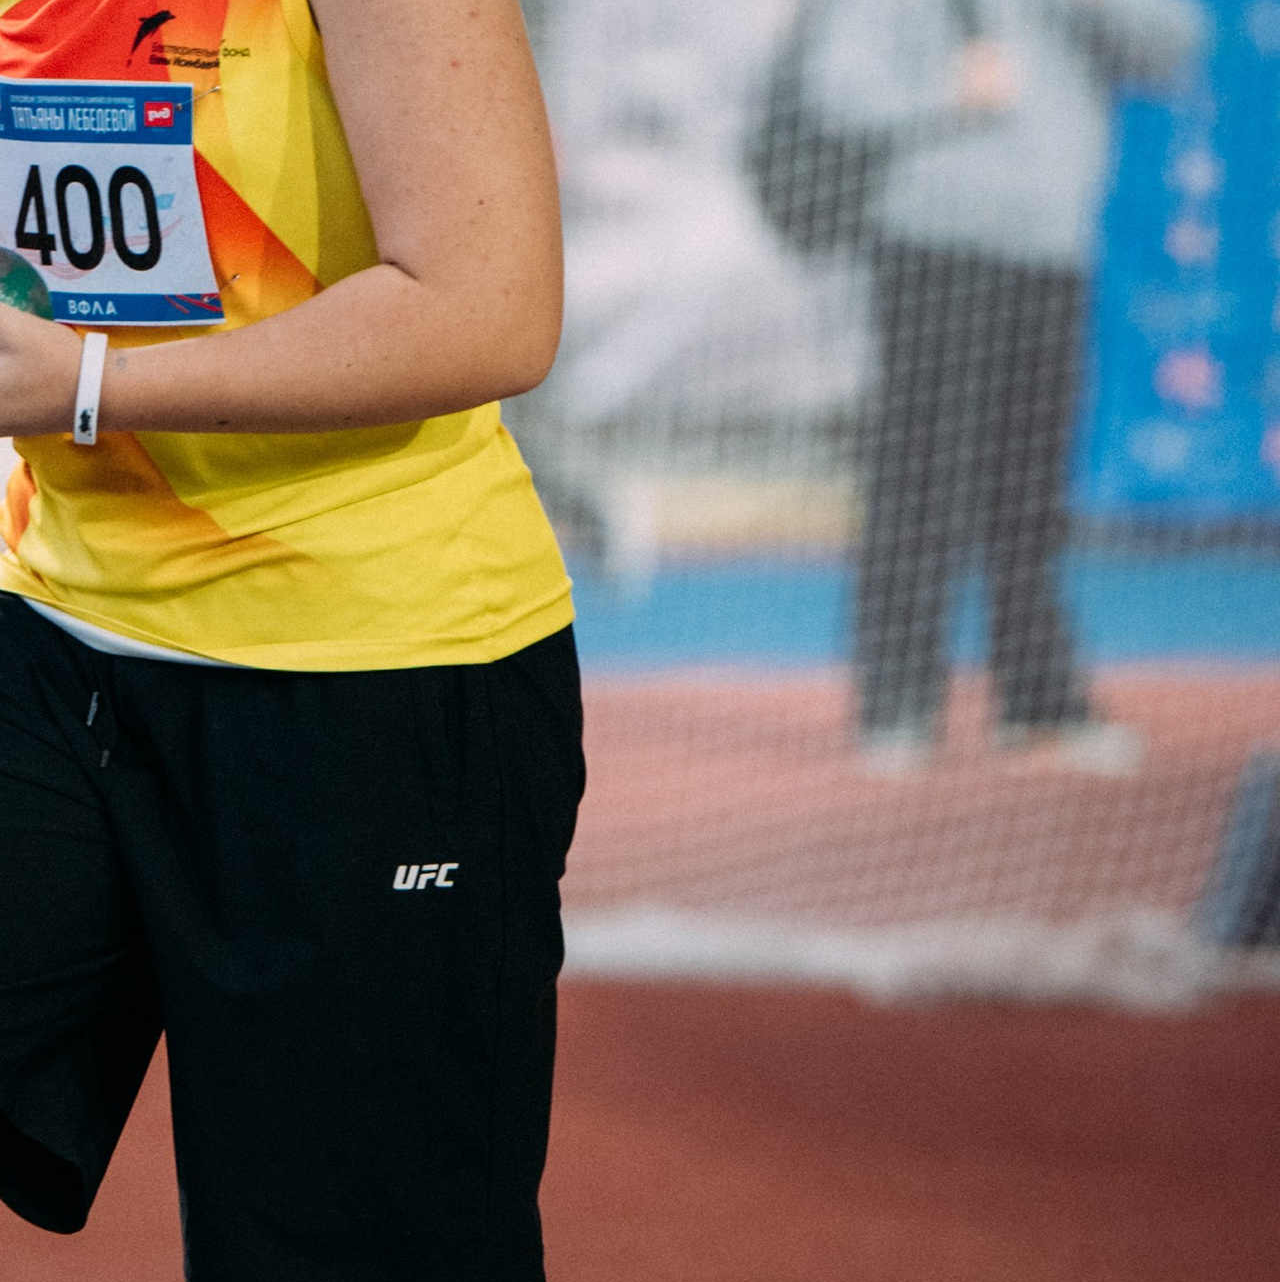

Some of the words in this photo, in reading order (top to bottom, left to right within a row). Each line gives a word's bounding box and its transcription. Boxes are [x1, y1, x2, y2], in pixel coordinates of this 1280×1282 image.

[11, 106, 65, 131] ТАТЬЯНЫ
[68, 104, 137, 134] ЛЕБЕДЕВОЙ
[15, 164, 162, 271] 400
[68, 299, 117, 316] ВФЛА
[393, 862, 459, 890] UFC
